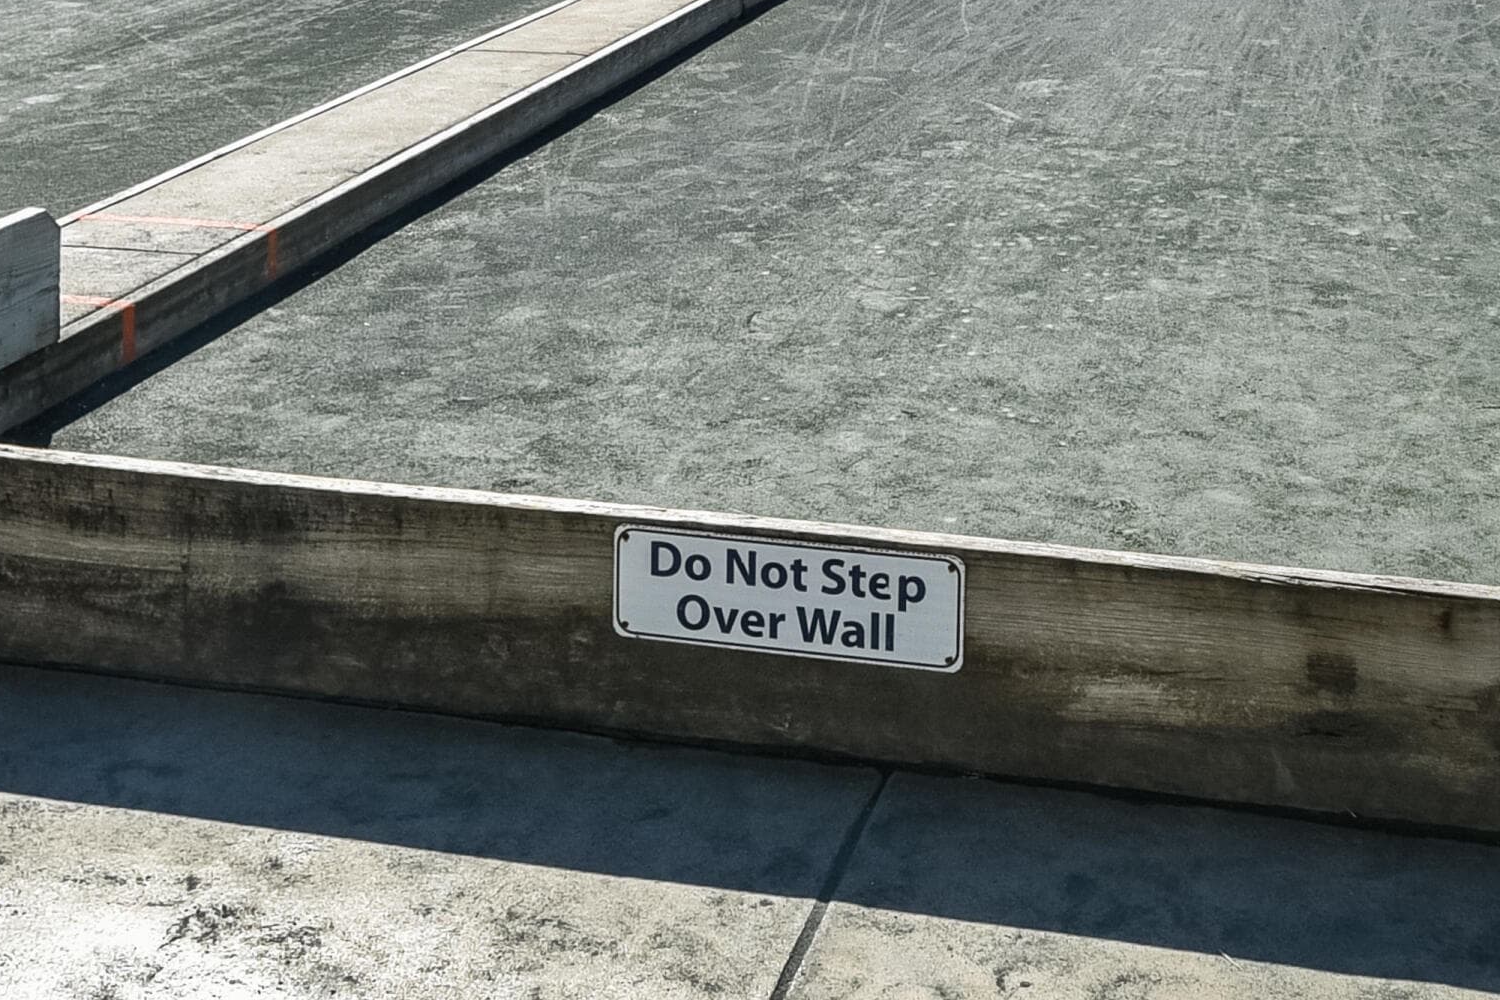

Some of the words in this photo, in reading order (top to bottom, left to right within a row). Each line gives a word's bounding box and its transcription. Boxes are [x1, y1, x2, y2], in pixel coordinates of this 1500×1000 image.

[650, 540, 712, 581] Do
[725, 548, 808, 593] Not
[820, 558, 927, 613] Step
[676, 594, 786, 640] Over
[795, 605, 895, 652] Wall
